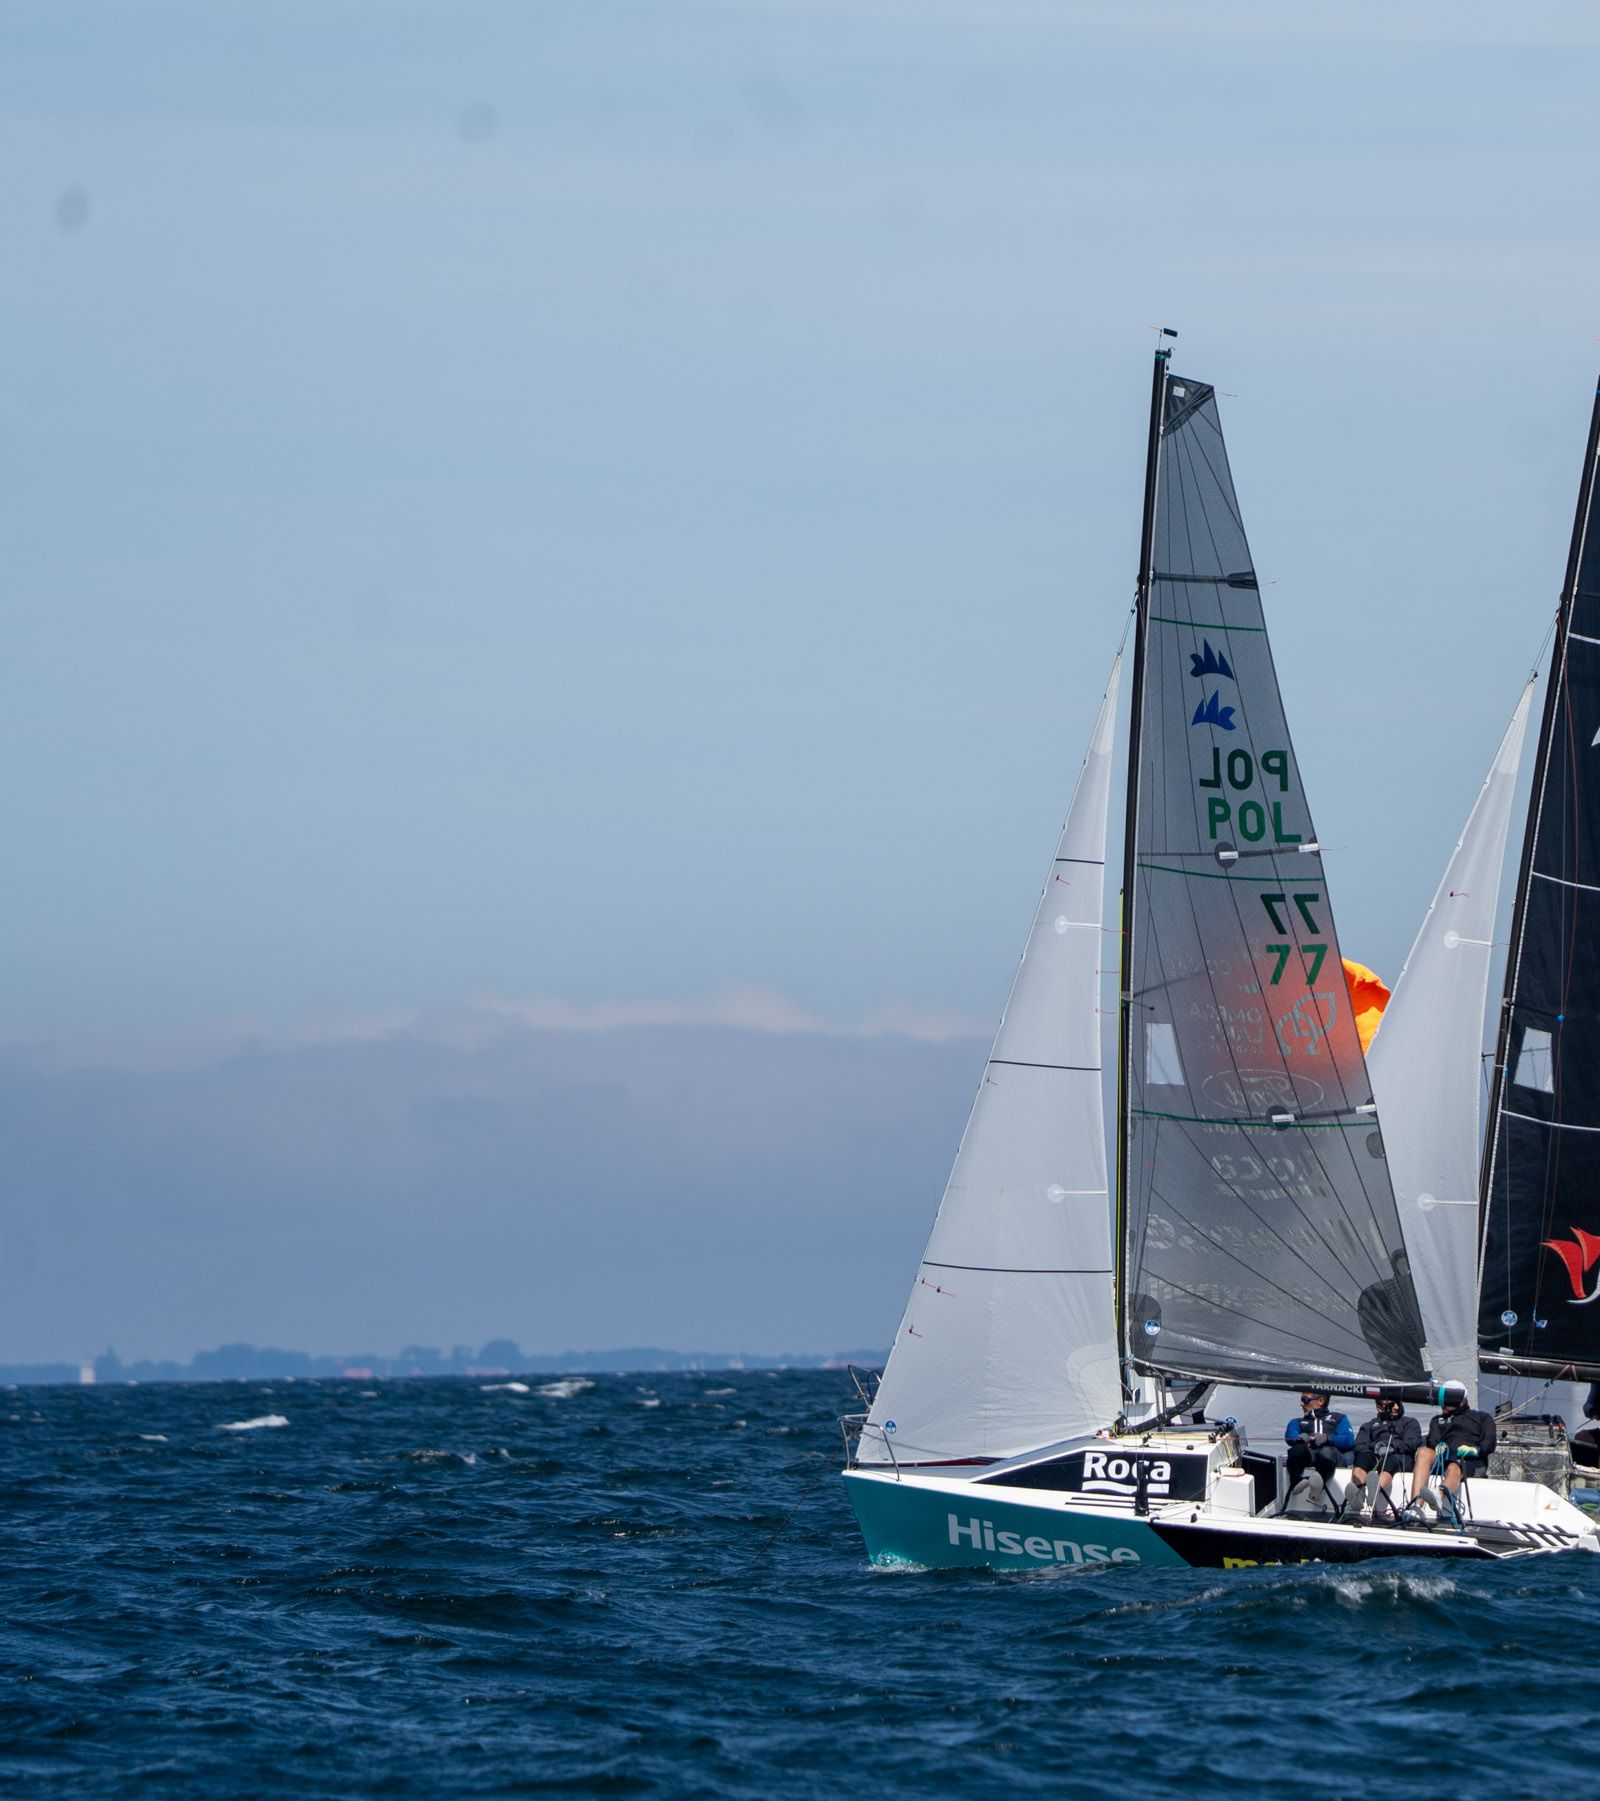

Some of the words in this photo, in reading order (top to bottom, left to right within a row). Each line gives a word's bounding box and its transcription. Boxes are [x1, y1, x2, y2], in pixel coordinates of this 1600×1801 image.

[1207, 797, 1301, 843] POL
[1266, 944, 1328, 985] 77
[1083, 1452, 1171, 1482] Roca
[948, 1513, 1141, 1565] Hisense
